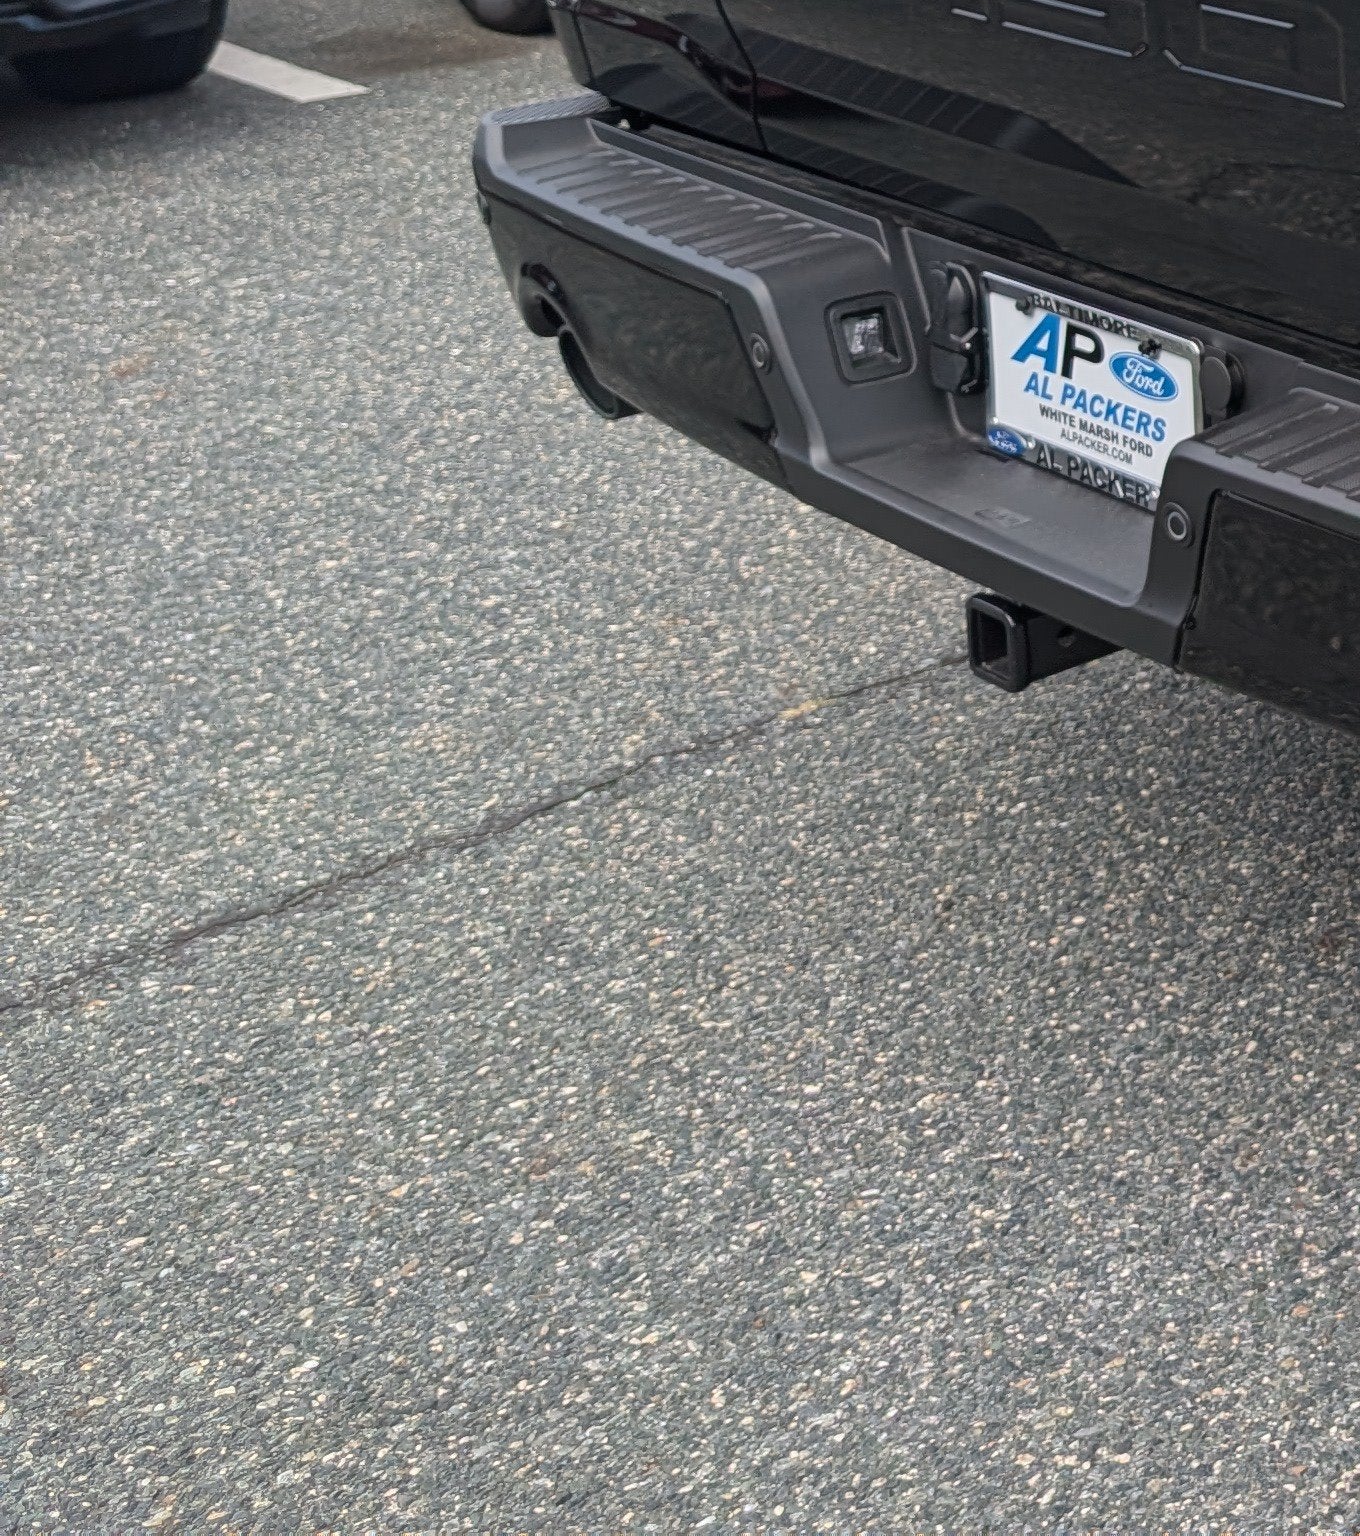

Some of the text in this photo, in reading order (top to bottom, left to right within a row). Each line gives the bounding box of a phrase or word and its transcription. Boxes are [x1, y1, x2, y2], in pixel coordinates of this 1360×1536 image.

[1032, 292, 1137, 339] BALTIMORE
[1011, 312, 1106, 380] AP
[1024, 371, 1053, 401] AL
[1060, 383, 1167, 442] PACKERS
[1038, 403, 1154, 458] WHITE MARSH FORD
[1036, 443, 1150, 508] AL PACKER
[1060, 428, 1134, 465] ALPACKER.COM
